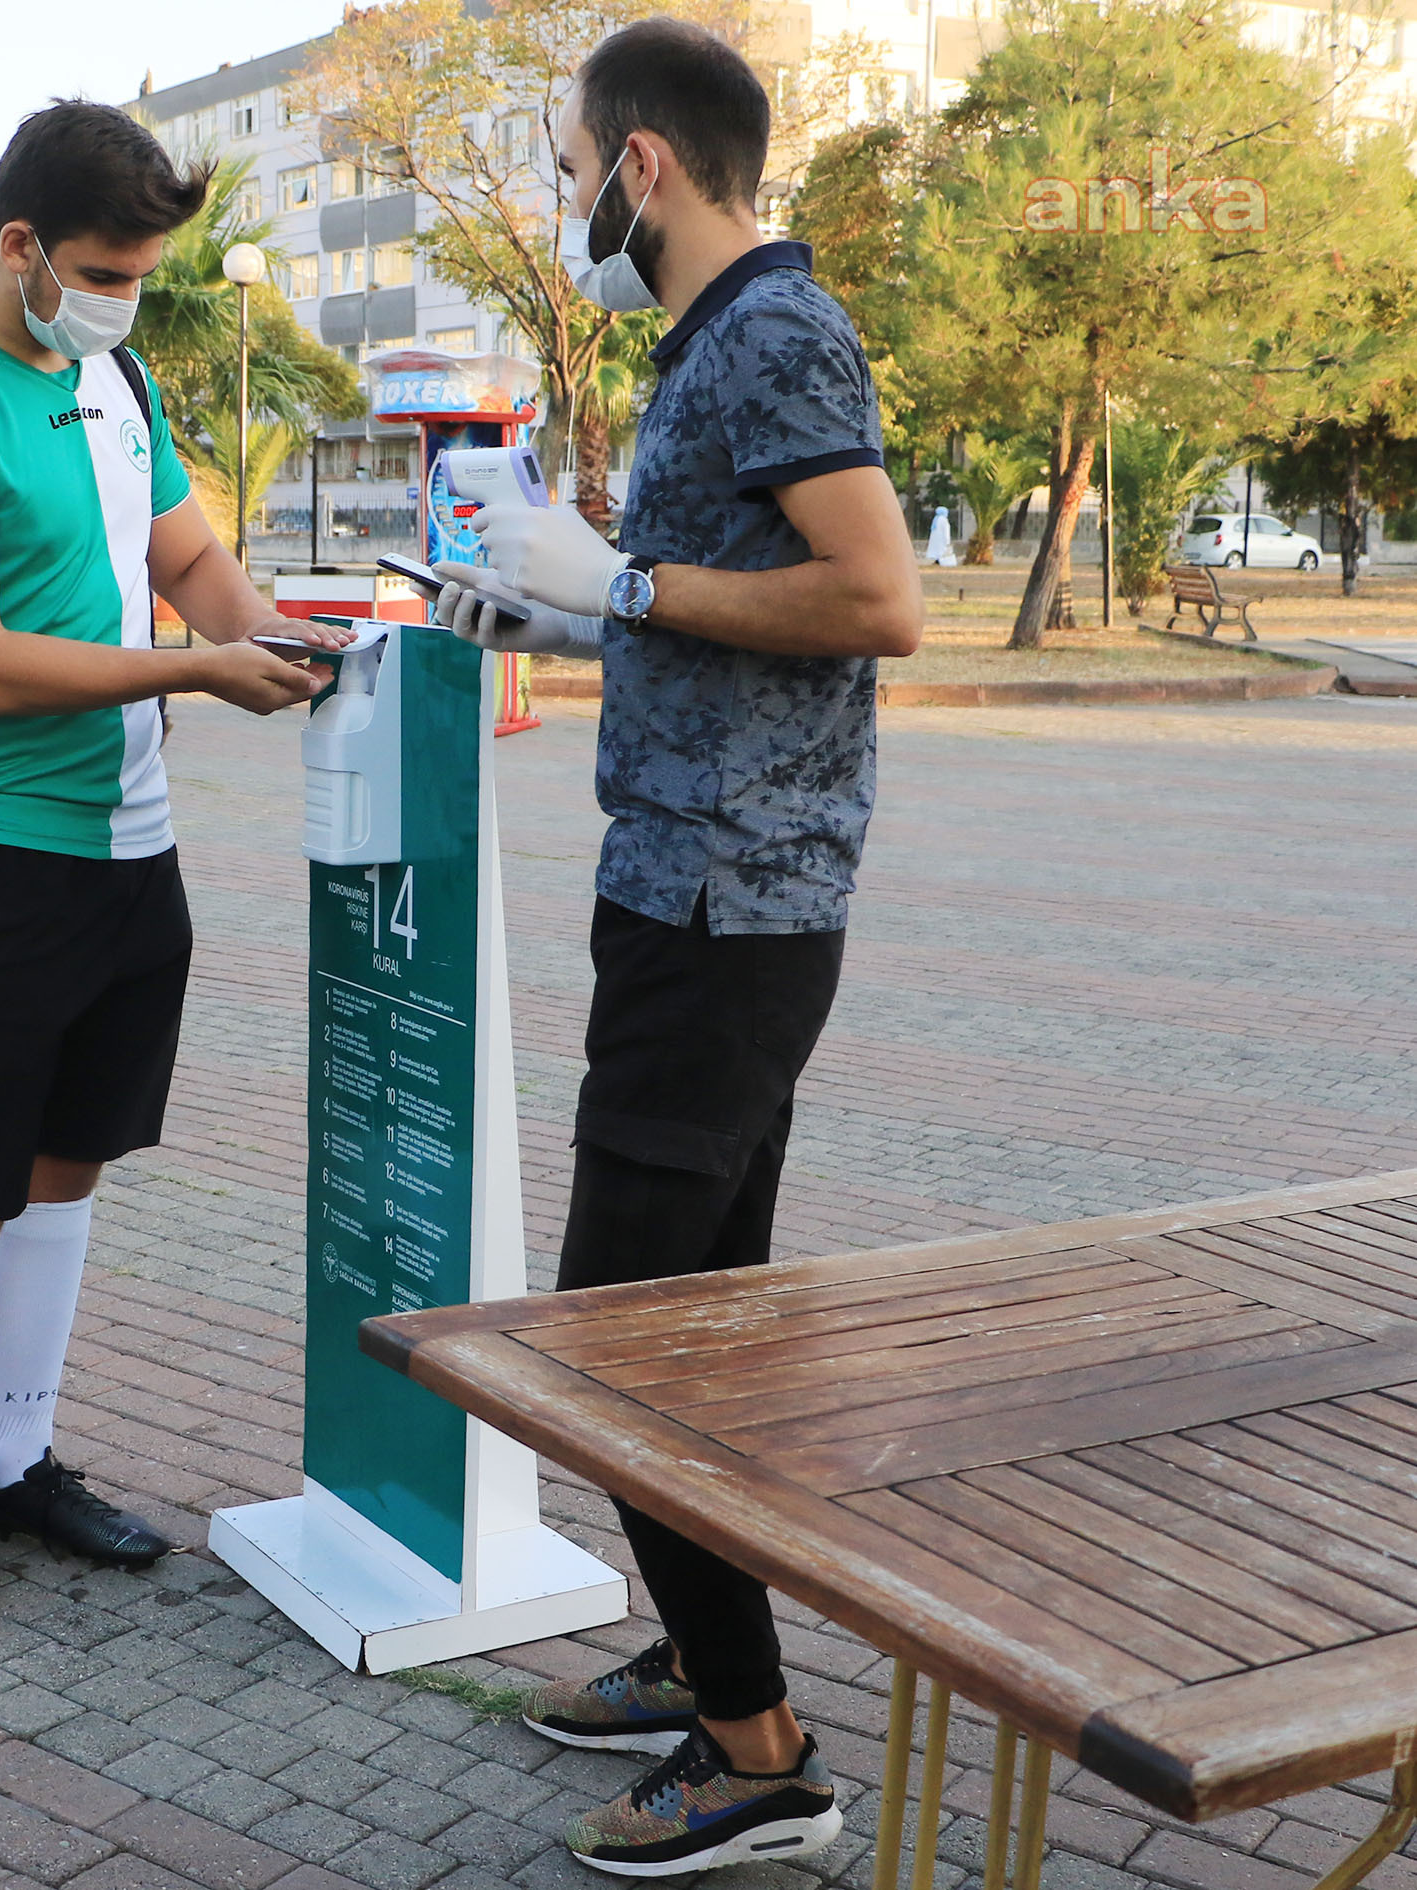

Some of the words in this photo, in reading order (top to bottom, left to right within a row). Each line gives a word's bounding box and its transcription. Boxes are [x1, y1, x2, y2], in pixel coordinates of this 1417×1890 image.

[364, 863, 418, 960] 14
[372, 952, 402, 978] KURAL
[325, 989, 330, 1006] 1
[390, 1012, 397, 1030] 8
[324, 1025, 330, 1042] 2
[390, 1050, 397, 1068] 9
[323, 1061, 330, 1078] 3
[323, 1097, 329, 1113] 4
[386, 1087, 396, 1106] 10
[323, 1132, 329, 1149] 5
[386, 1124, 394, 1143] 11
[322, 1168, 329, 1184] 6
[385, 1161, 395, 1182] 12
[322, 1202, 329, 1218] 7
[384, 1198, 394, 1218] 13
[384, 1235, 394, 1255] 14
